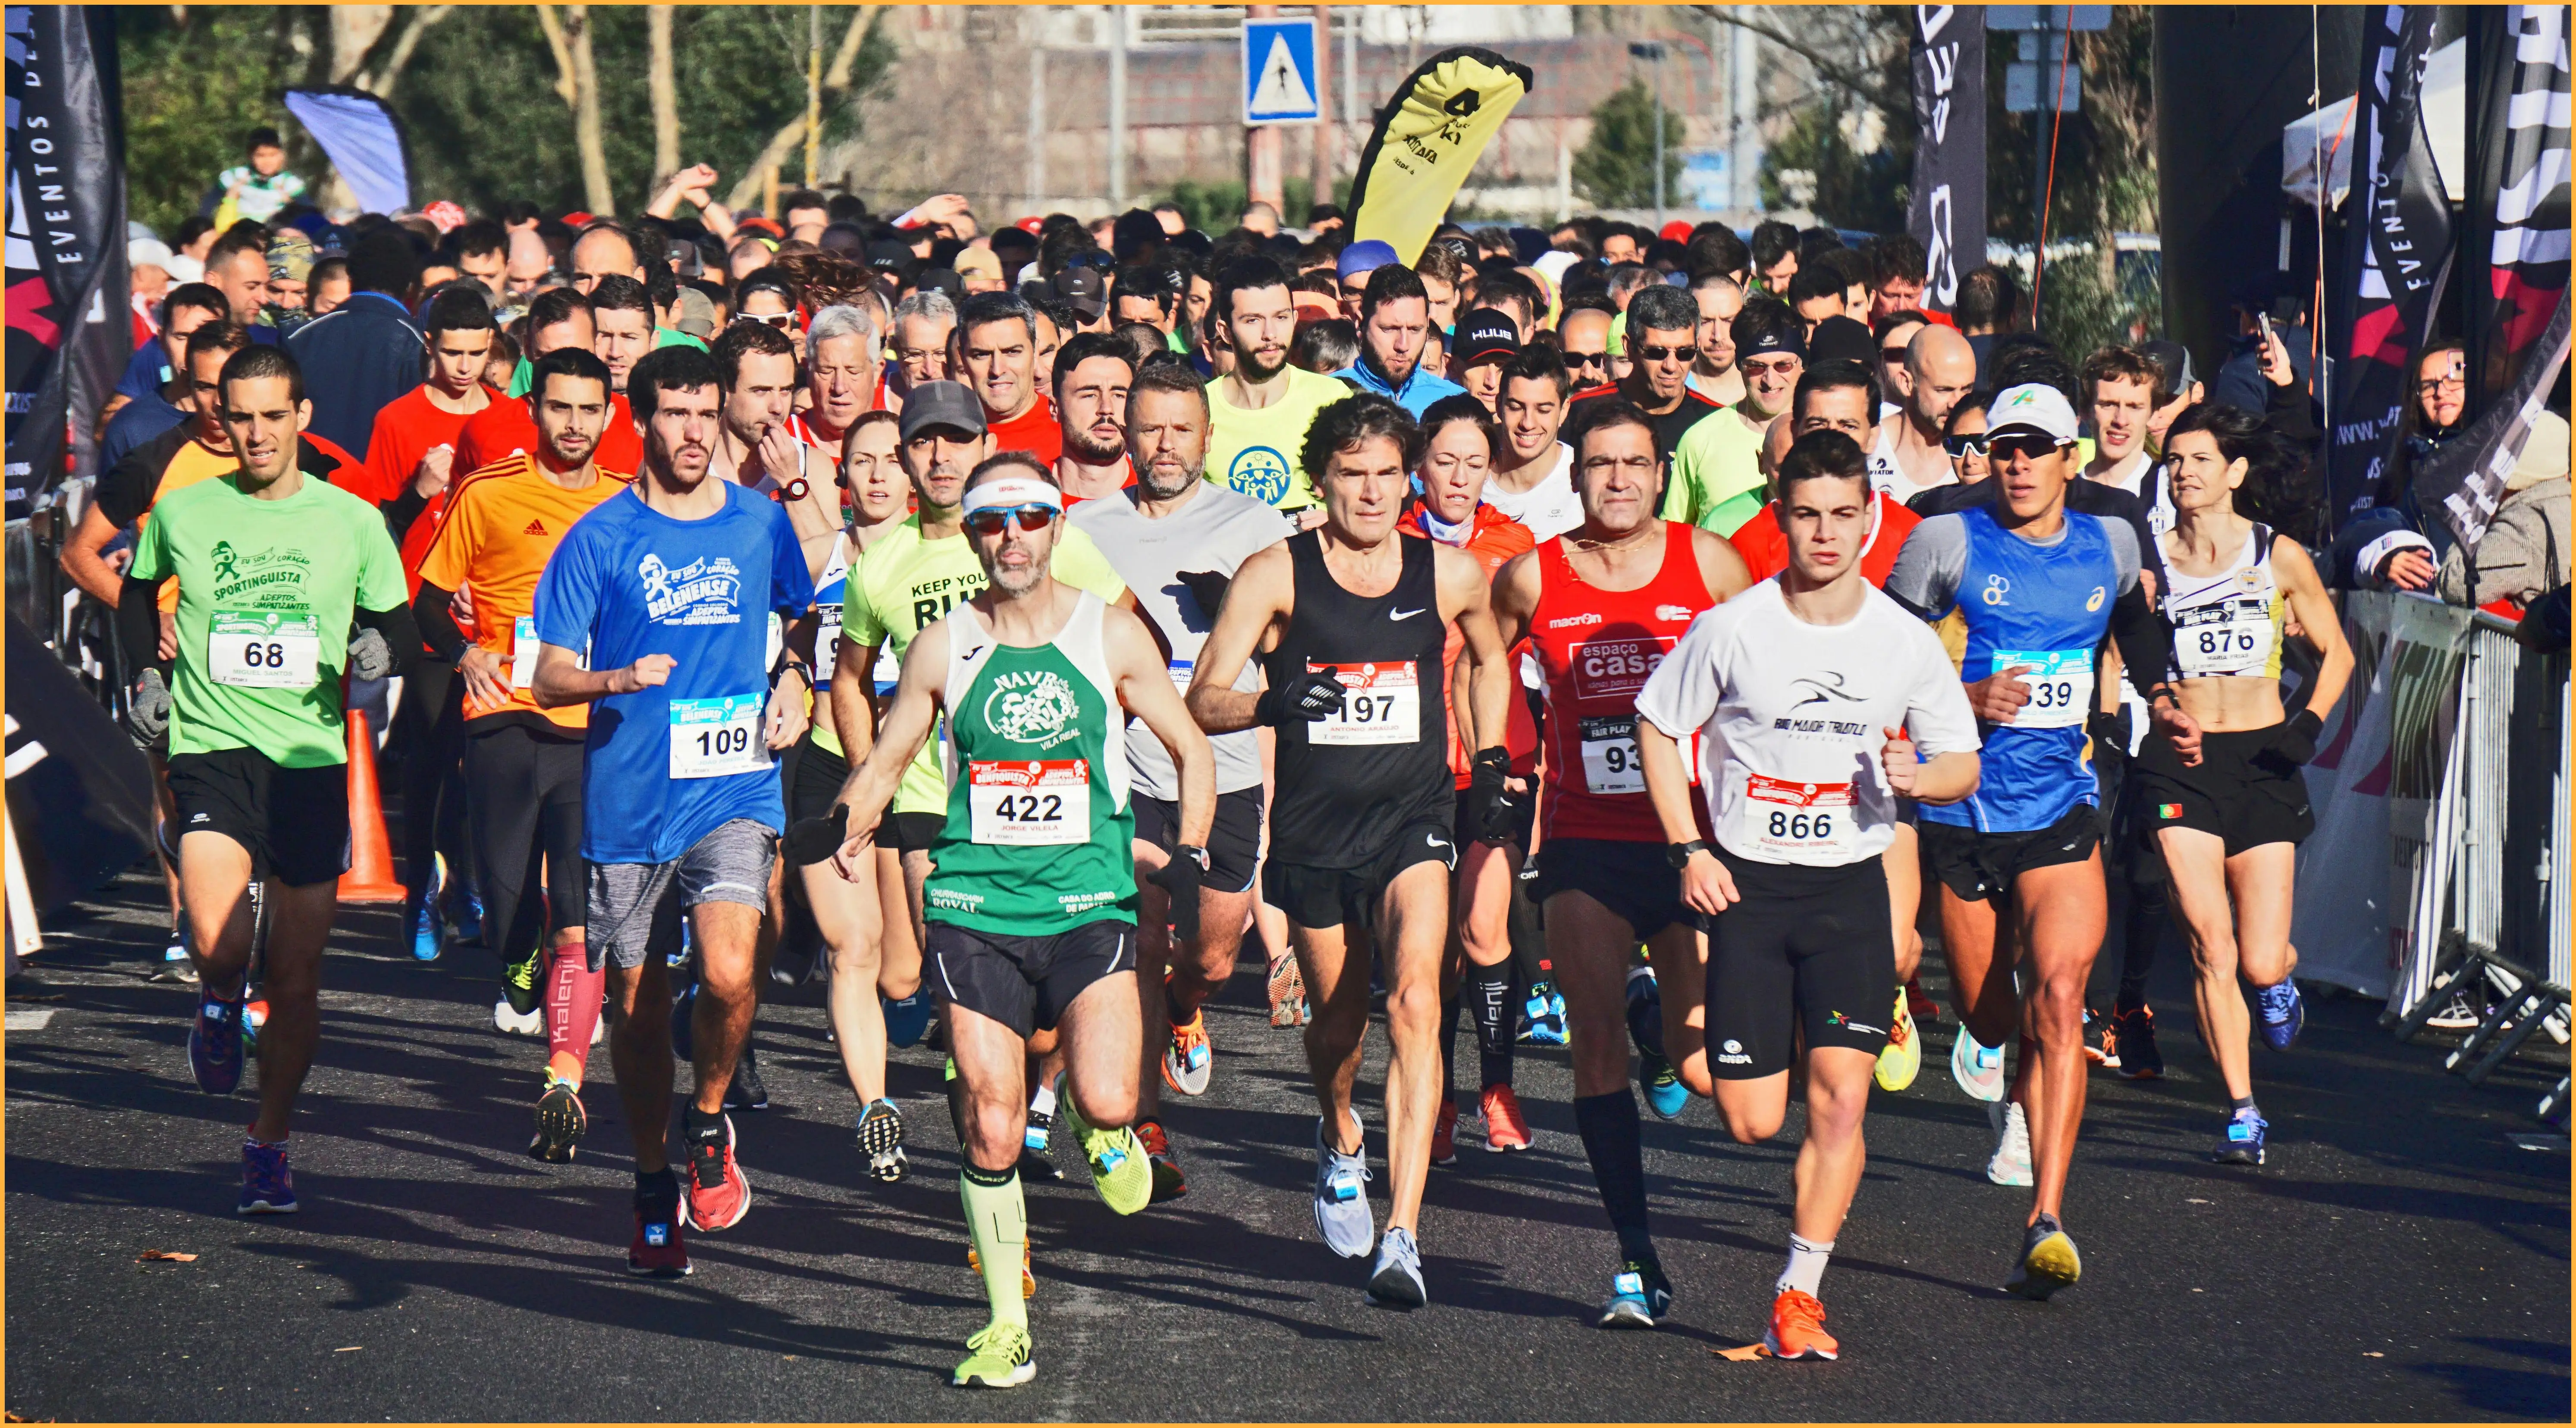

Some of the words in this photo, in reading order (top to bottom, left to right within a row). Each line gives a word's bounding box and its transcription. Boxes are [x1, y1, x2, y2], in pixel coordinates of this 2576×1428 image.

[27, 116, 82, 264] EVENTOS
[2378, 154, 2431, 291] EVENTO
[1472, 328, 1512, 341] HUUB
[254, 555, 266, 563] SOU
[277, 555, 310, 565] CORAÇÃO
[214, 572, 300, 601] SPORTINGUISTA
[912, 579, 951, 597] KEEP
[647, 579, 730, 619] BELENENSE
[1550, 613, 1602, 629] macron
[1582, 643, 1638, 657] espaço
[2199, 627, 2254, 654] 876
[245, 642, 283, 668] 68
[1585, 653, 1665, 677] casa
[1340, 695, 1394, 723] 197
[697, 727, 747, 756] 109
[1040, 737, 1060, 751] VILA
[1059, 727, 1081, 742] REAL
[1591, 727, 1608, 737] FAIR
[1610, 725, 1632, 734] PLAY
[976, 772, 1030, 785] BENFIQUISTA
[996, 795, 1062, 821] 422
[1769, 811, 1831, 839] 866
[1760, 837, 1804, 847] ALEXANDRE
[931, 889, 984, 904] CHURRASCARIA
[1058, 895, 1081, 904] CASA
[1081, 894, 1094, 902] DO
[1066, 903, 1077, 913] DE
